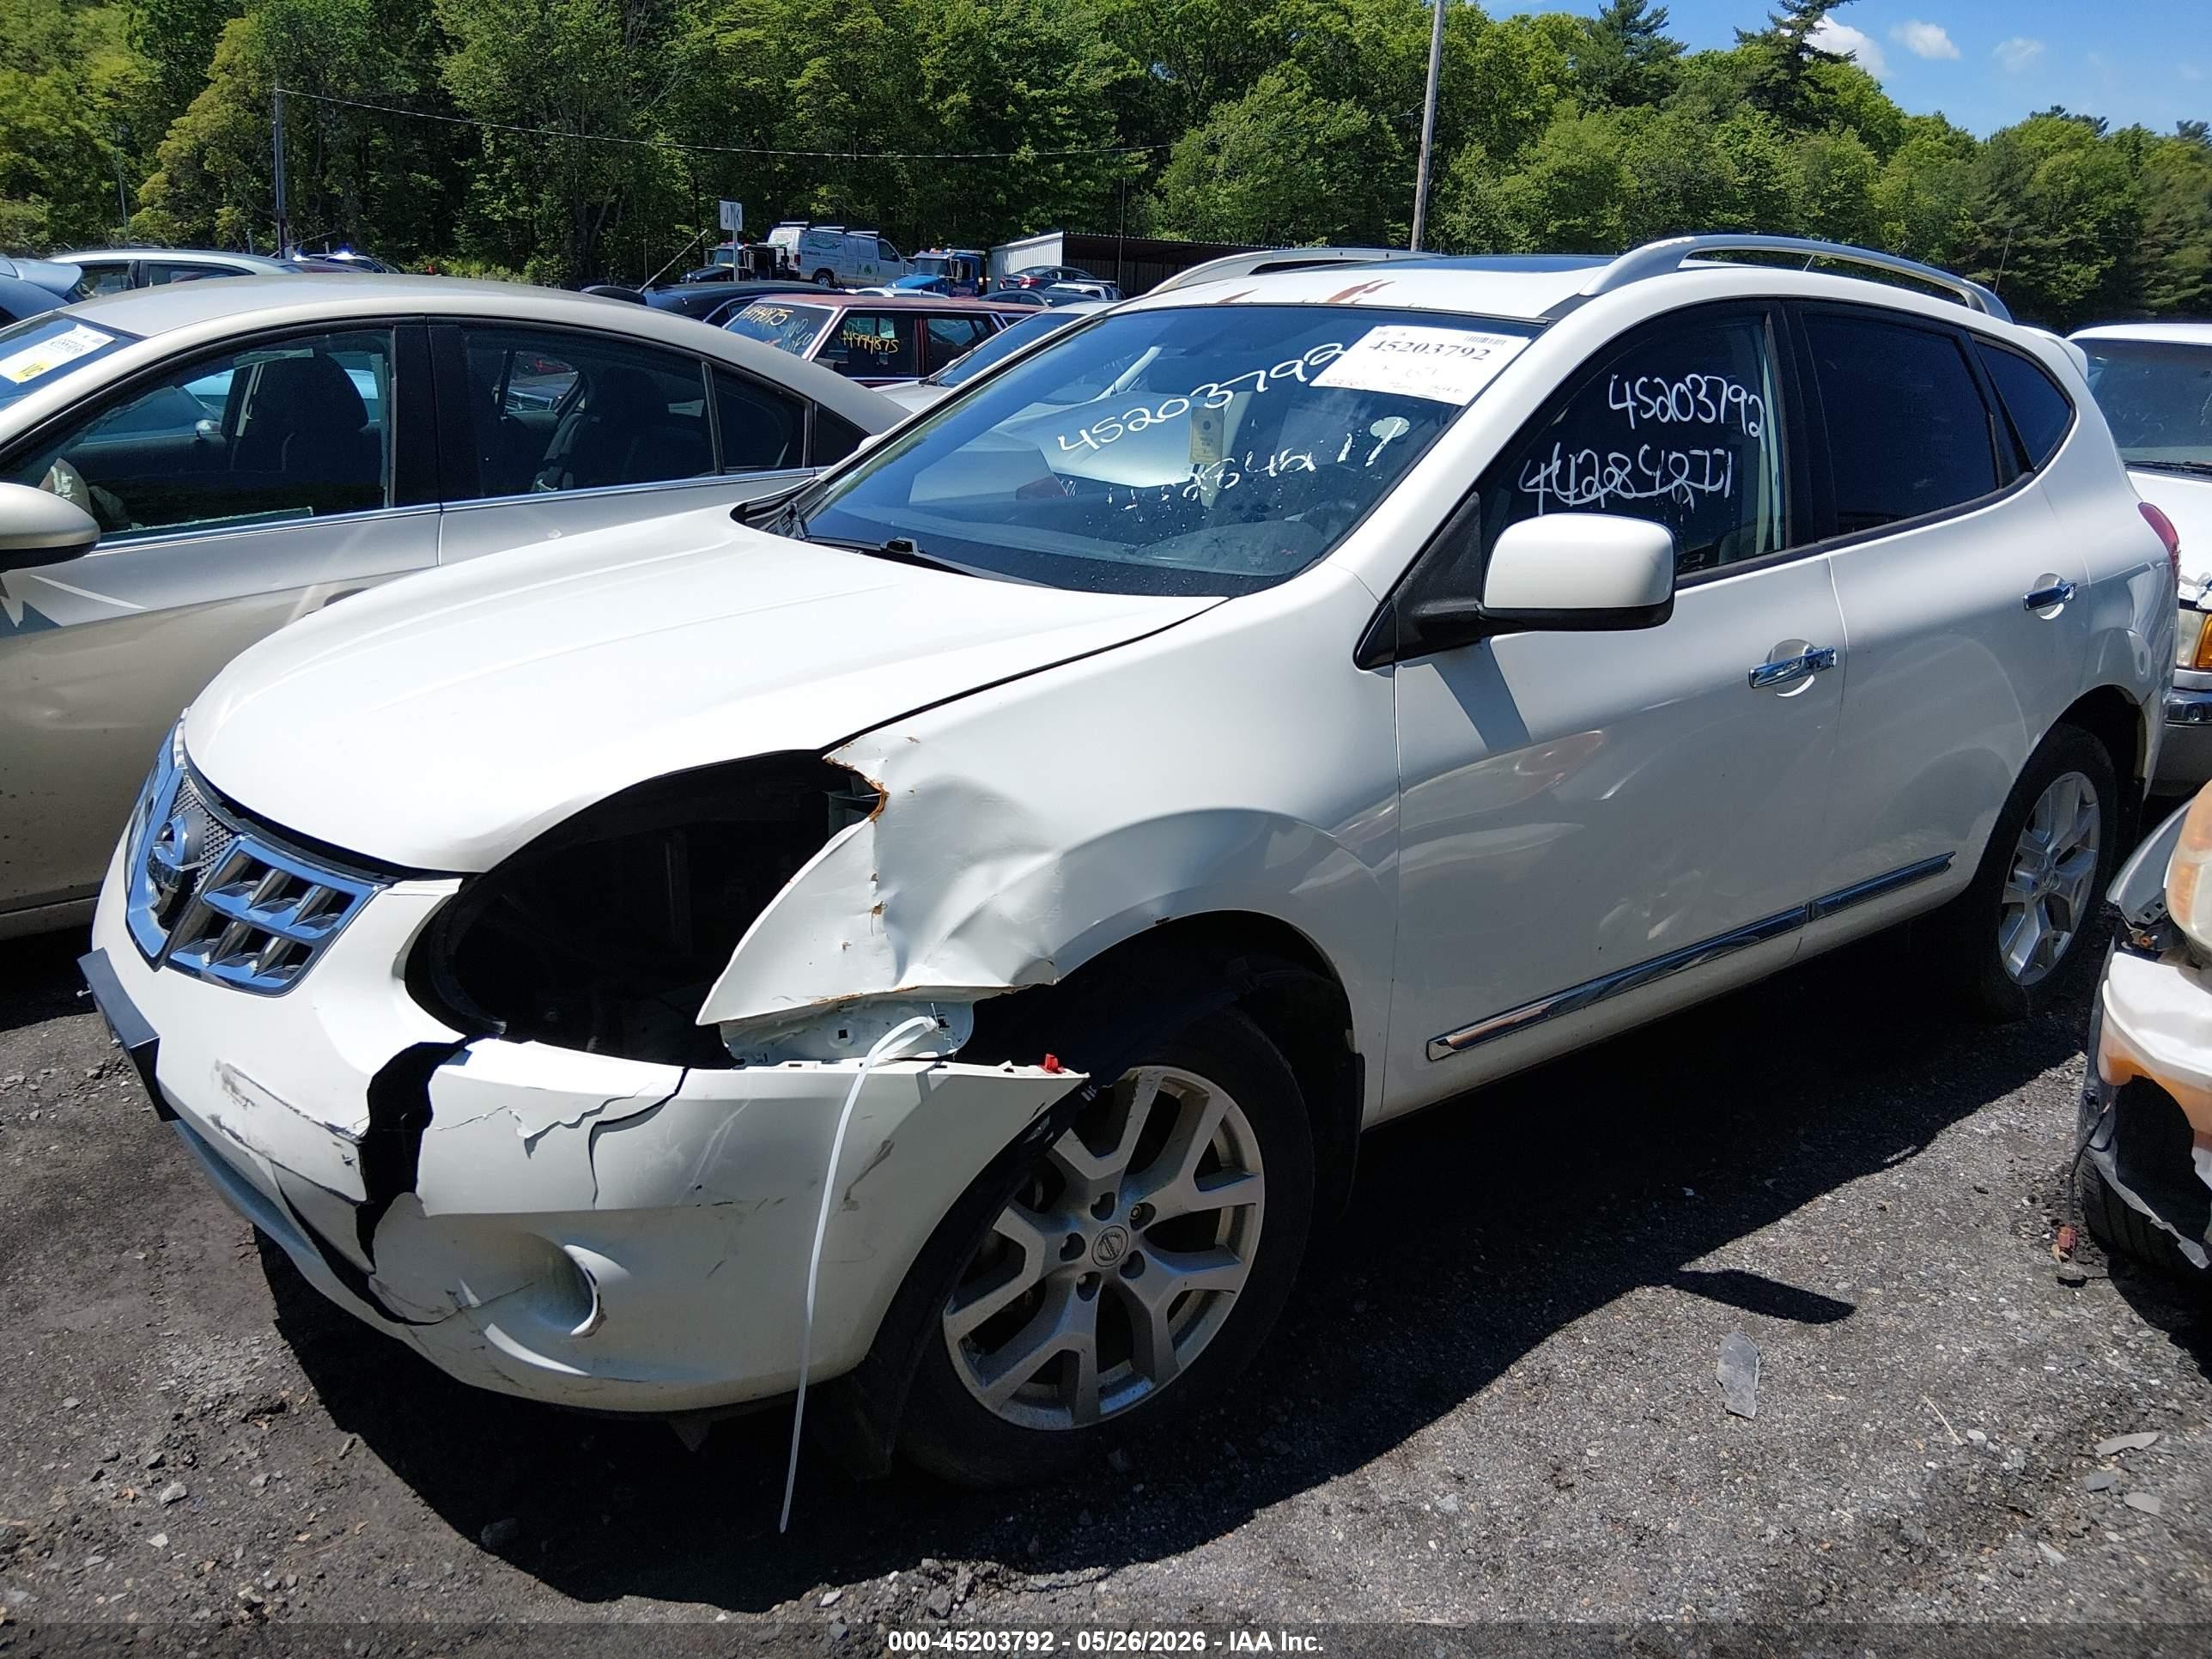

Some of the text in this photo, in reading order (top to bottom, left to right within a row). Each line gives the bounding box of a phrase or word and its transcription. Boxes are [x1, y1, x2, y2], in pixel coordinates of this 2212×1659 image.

[839, 330, 900, 355] 44994875
[1369, 340, 1492, 361] 45203792
[1057, 343, 1347, 451] 45203792
[1608, 374, 1765, 437] 45203792
